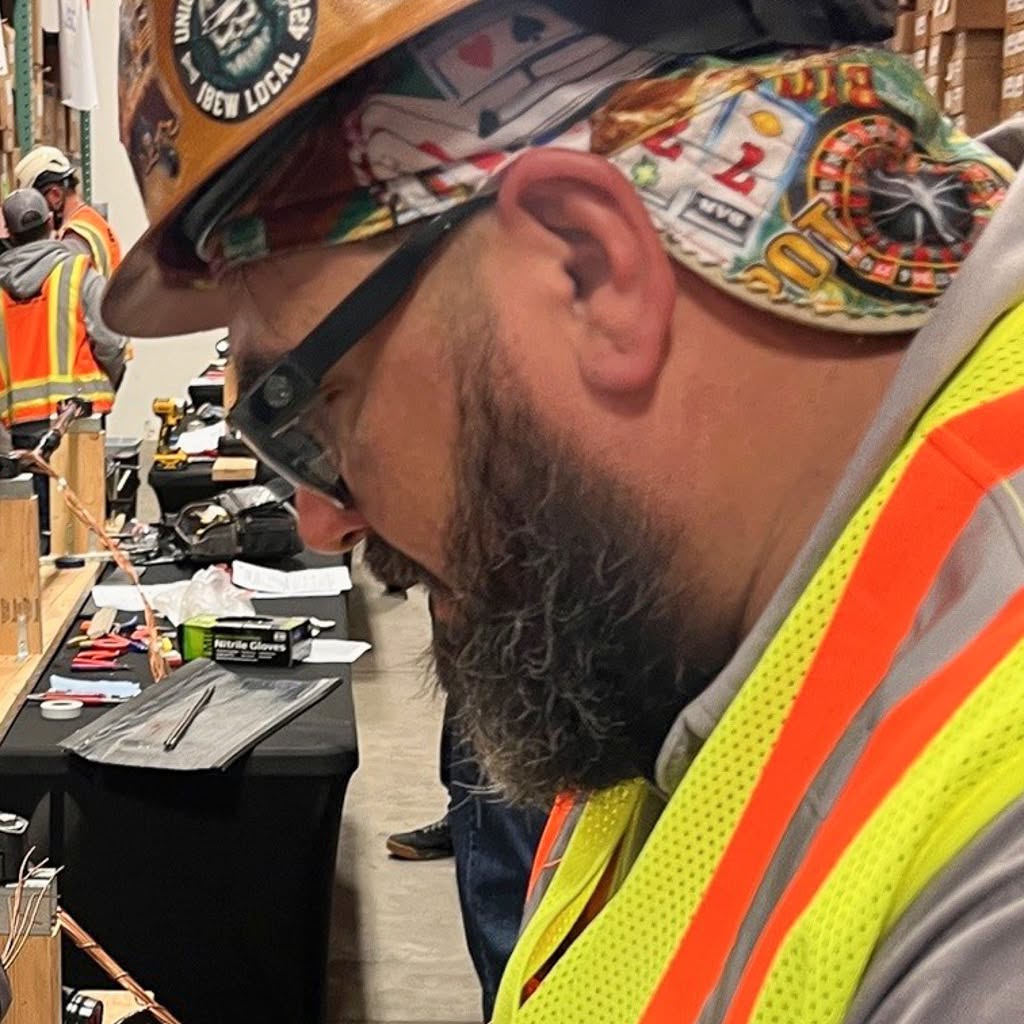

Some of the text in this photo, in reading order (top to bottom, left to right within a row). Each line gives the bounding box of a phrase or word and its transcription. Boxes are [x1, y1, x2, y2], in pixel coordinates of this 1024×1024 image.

[196, 81, 240, 119] IBEW
[244, 52, 301, 114] LOCAL
[214, 639, 287, 652] Nitrile Gloves
